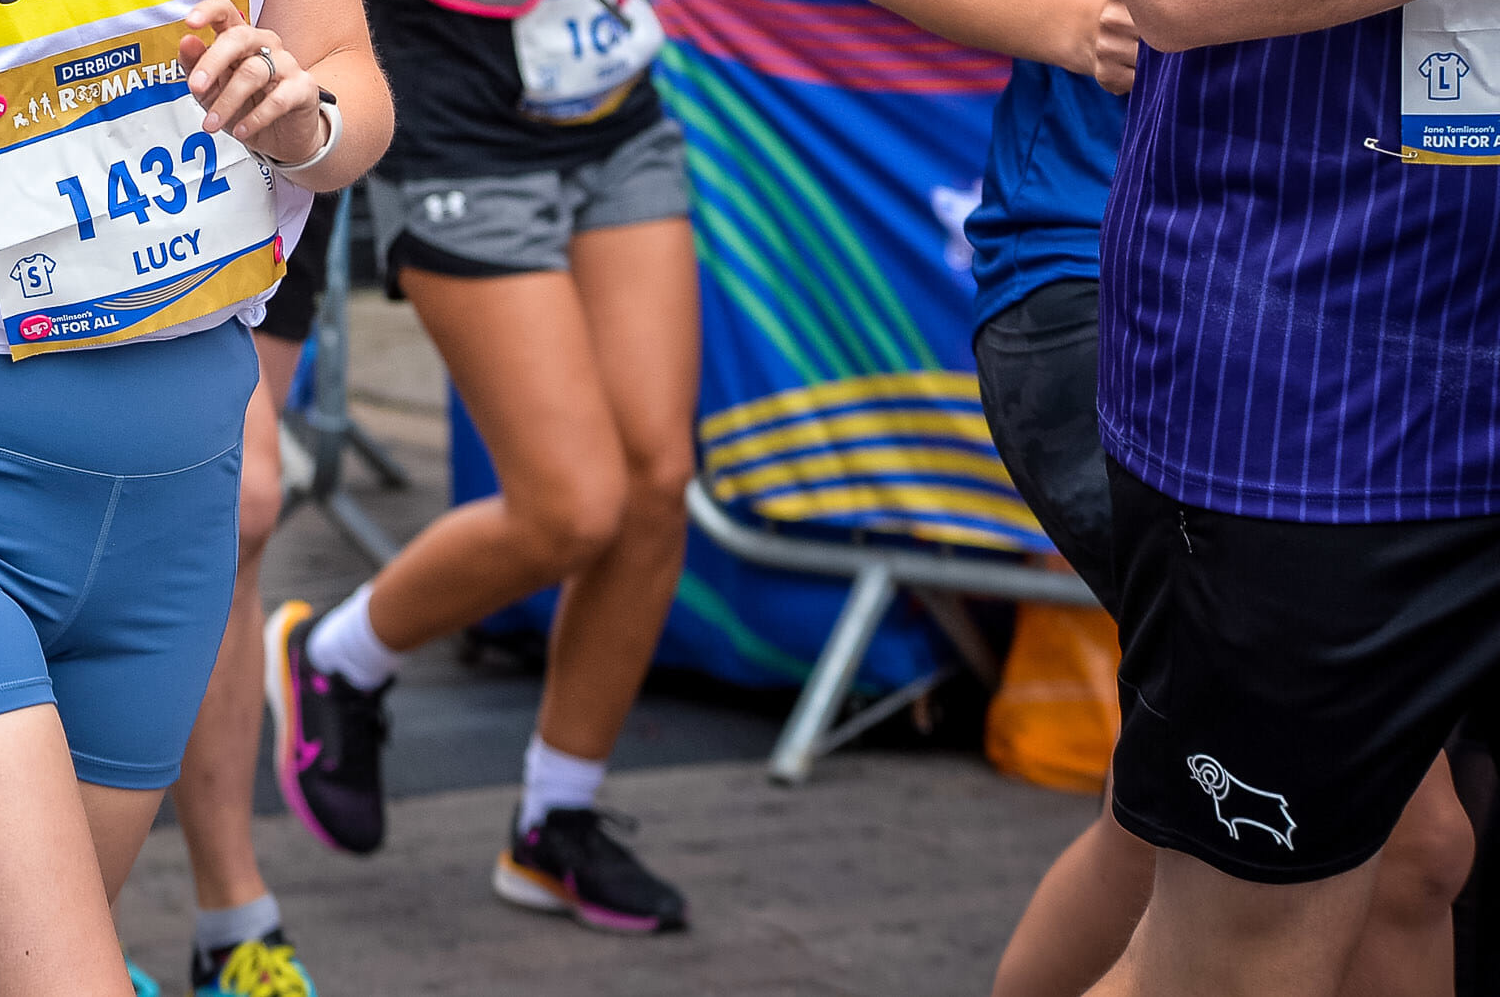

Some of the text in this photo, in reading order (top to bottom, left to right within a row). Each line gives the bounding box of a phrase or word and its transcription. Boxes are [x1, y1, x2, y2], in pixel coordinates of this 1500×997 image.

[61, 48, 136, 81] DERBION
[57, 57, 187, 112] RMATH
[1438, 66, 1450, 90] L
[1423, 125, 1495, 133] Jane Tomlinson's
[1423, 135, 1456, 148] RUN
[1460, 135, 1490, 148] FOR
[55, 131, 231, 241] 1432
[132, 228, 201, 276] LUCY
[27, 265, 42, 288] S
[61, 320, 91, 335] FOR
[94, 314, 120, 330] ALL
